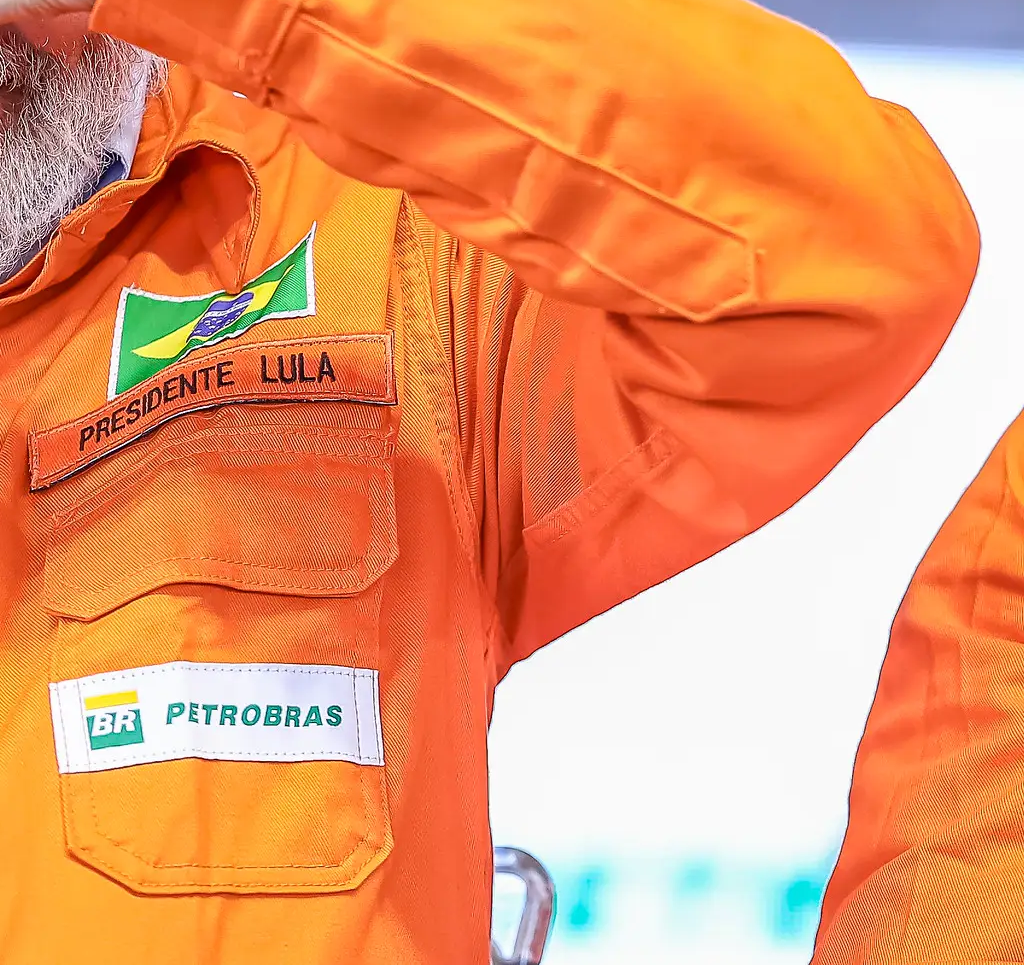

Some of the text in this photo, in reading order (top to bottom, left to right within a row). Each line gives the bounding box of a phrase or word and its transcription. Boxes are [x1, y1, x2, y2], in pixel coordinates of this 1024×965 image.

[78, 351, 337, 452] PRESIDENTE LULA
[90, 701, 343, 736] BR PETROBRAS
